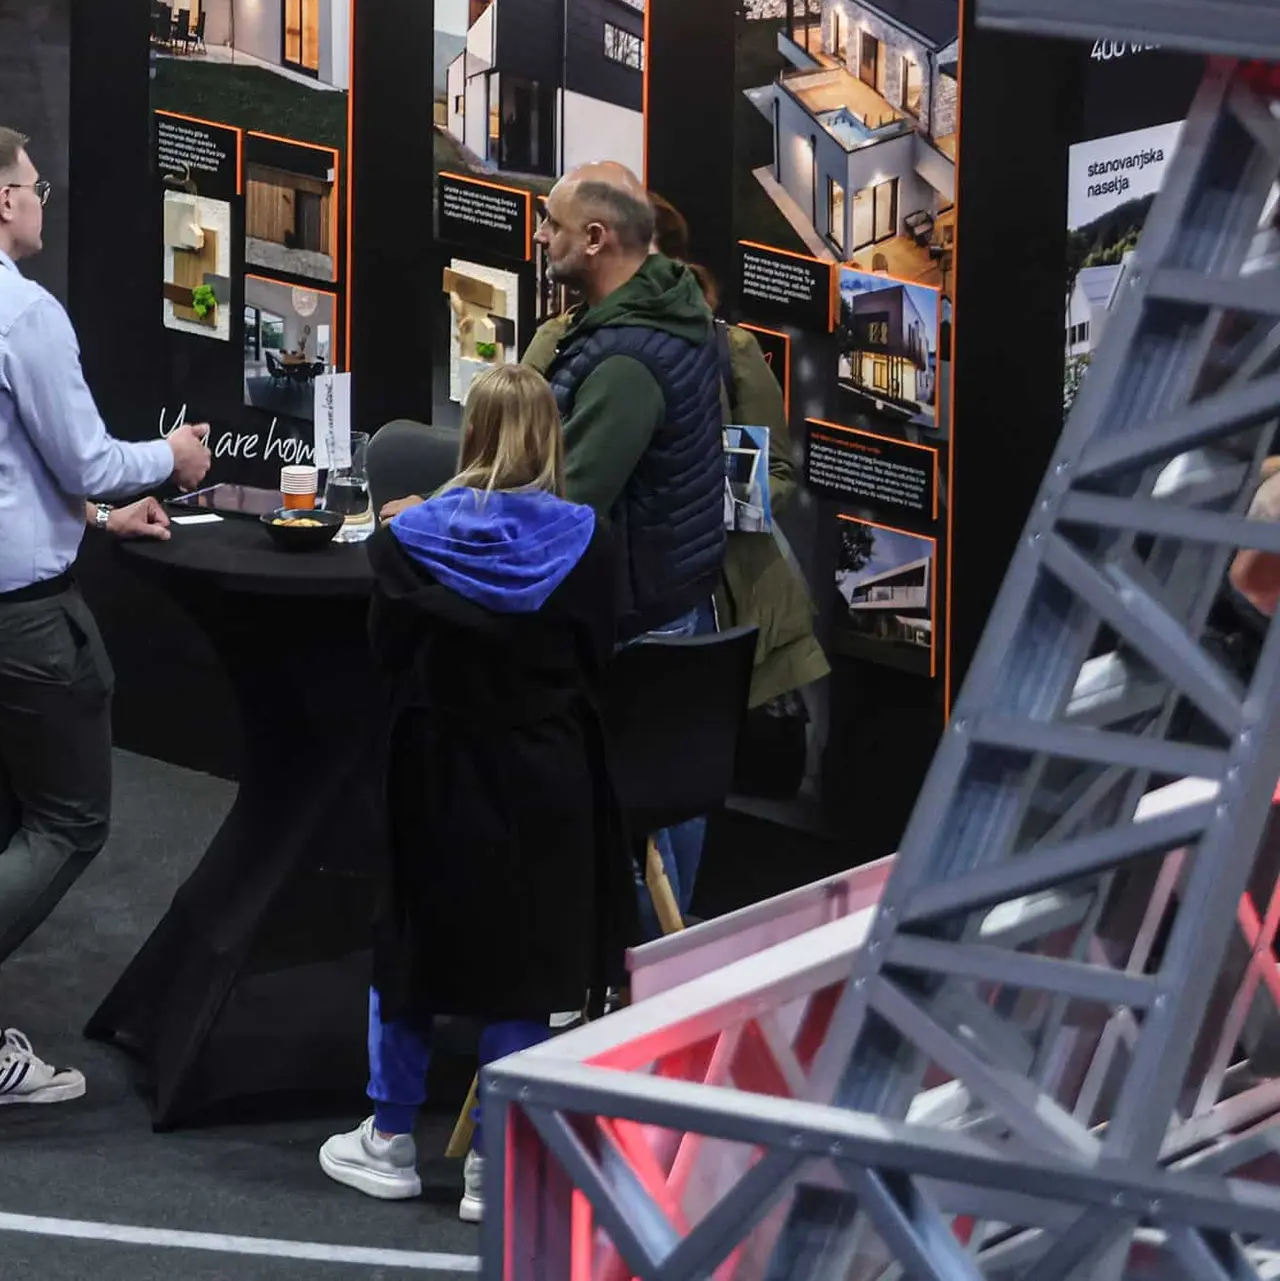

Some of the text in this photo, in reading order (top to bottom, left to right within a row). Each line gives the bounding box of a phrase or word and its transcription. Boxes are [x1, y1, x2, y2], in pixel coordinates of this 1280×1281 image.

[1090, 37, 1125, 61] 400
[1087, 147, 1165, 178] stanovanjska
[1086, 175, 1130, 199] naselja
[214, 431, 260, 459] are
[263, 416, 317, 465] hom
